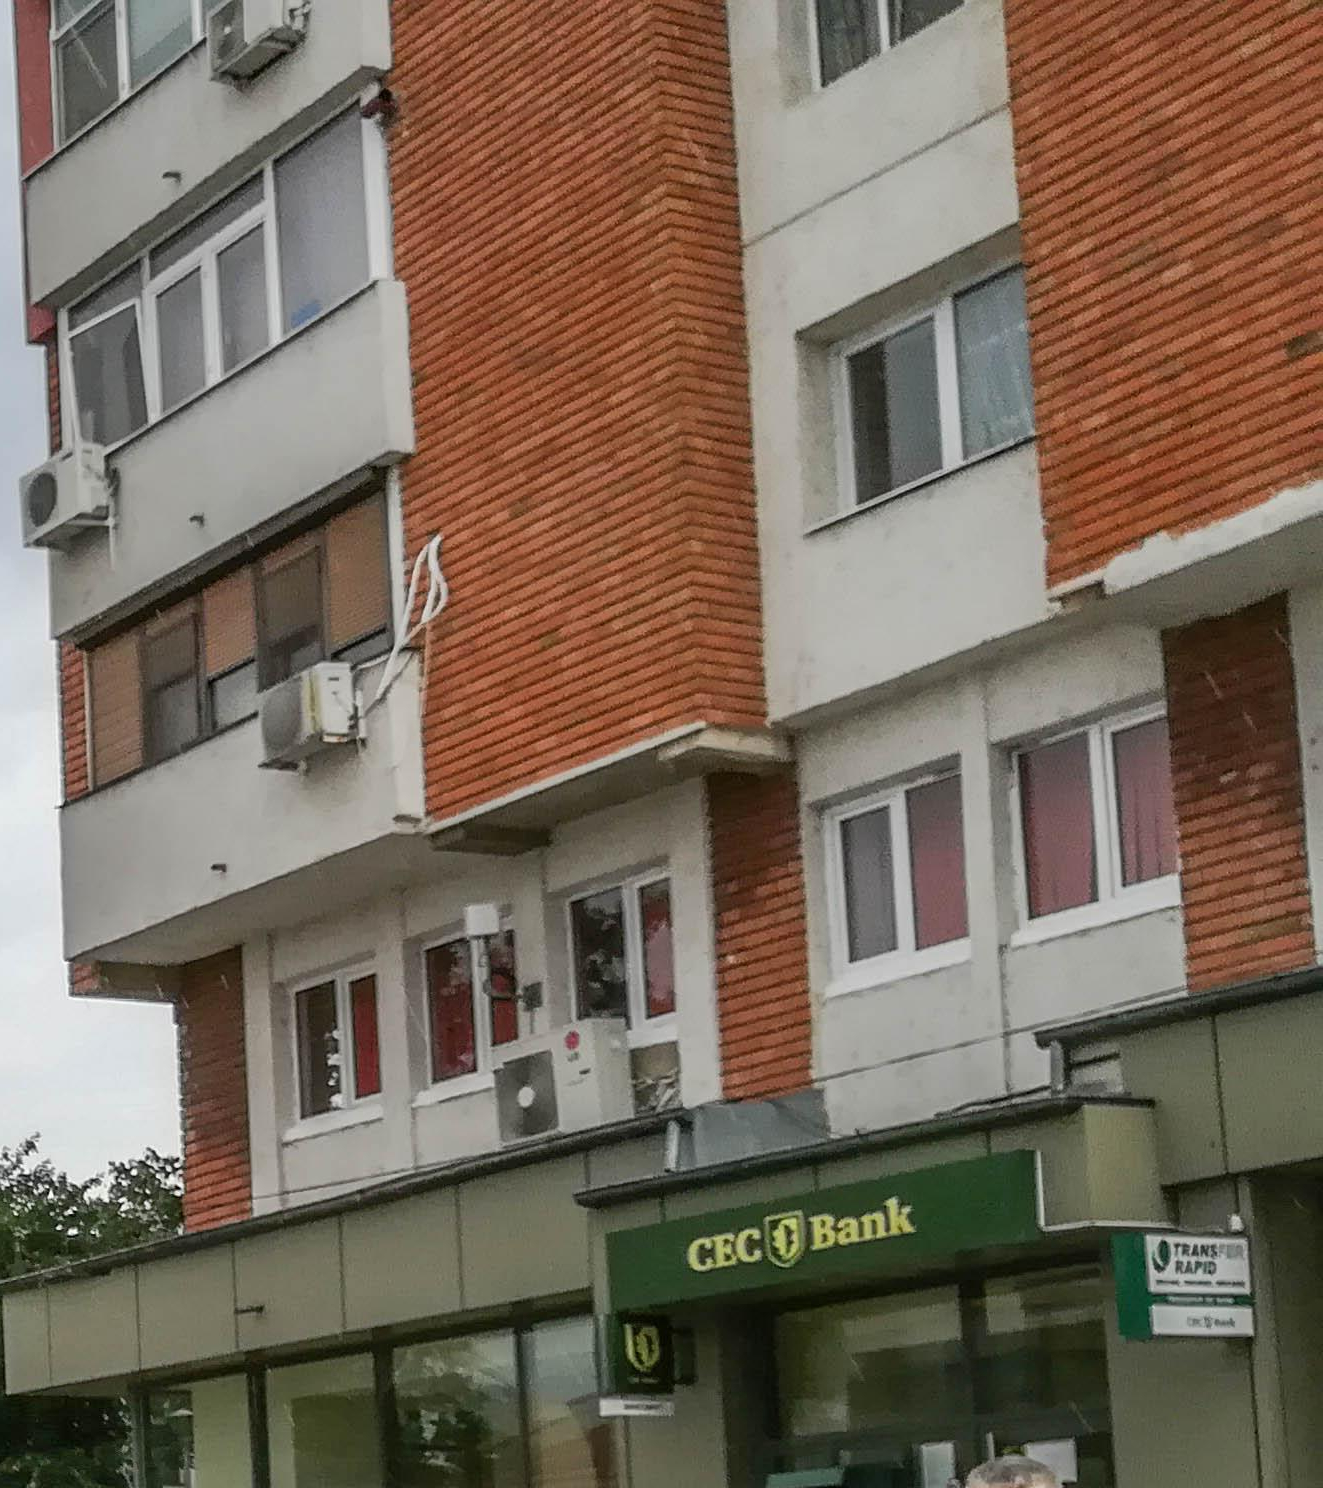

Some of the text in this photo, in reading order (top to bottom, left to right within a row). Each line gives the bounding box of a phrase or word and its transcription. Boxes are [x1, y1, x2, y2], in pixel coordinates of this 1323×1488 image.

[687, 1196, 917, 1272] CEC Bank
[1175, 1260, 1217, 1275] RAPID
